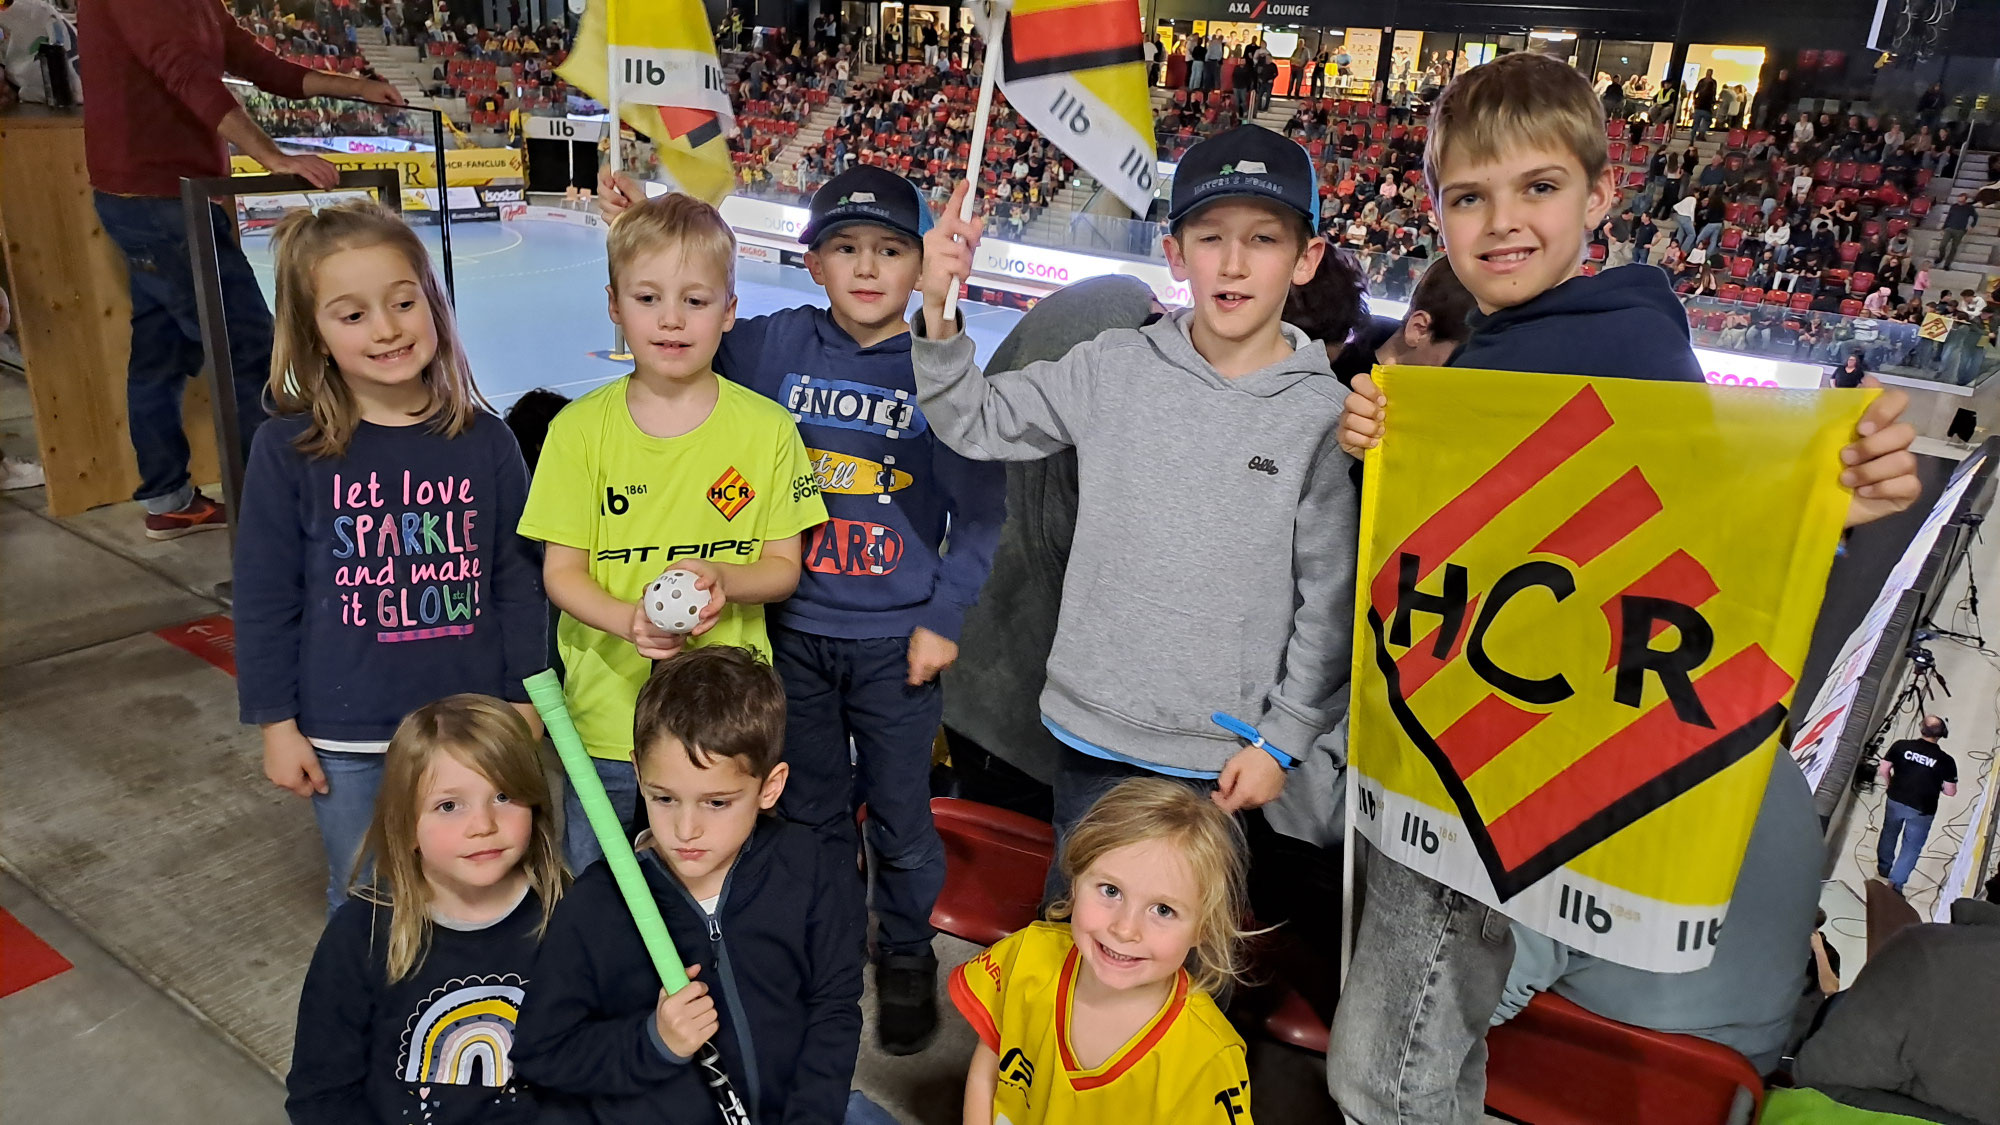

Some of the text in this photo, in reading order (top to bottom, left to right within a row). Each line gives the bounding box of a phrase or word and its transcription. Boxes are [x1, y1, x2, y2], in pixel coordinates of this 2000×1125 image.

[1229, 4, 1310, 17] AXA LOUNGE
[739, 245, 767, 258] MIGROS
[333, 469, 474, 510] let love
[624, 484, 647, 495] 1861
[711, 484, 750, 502] HCR
[332, 510, 479, 559] SPARKLE
[667, 538, 760, 562] PIPE
[335, 554, 482, 587] and make
[340, 580, 481, 628] it GLOW!
[1389, 552, 1717, 730] HCR
[1903, 750, 1938, 769] CREW
